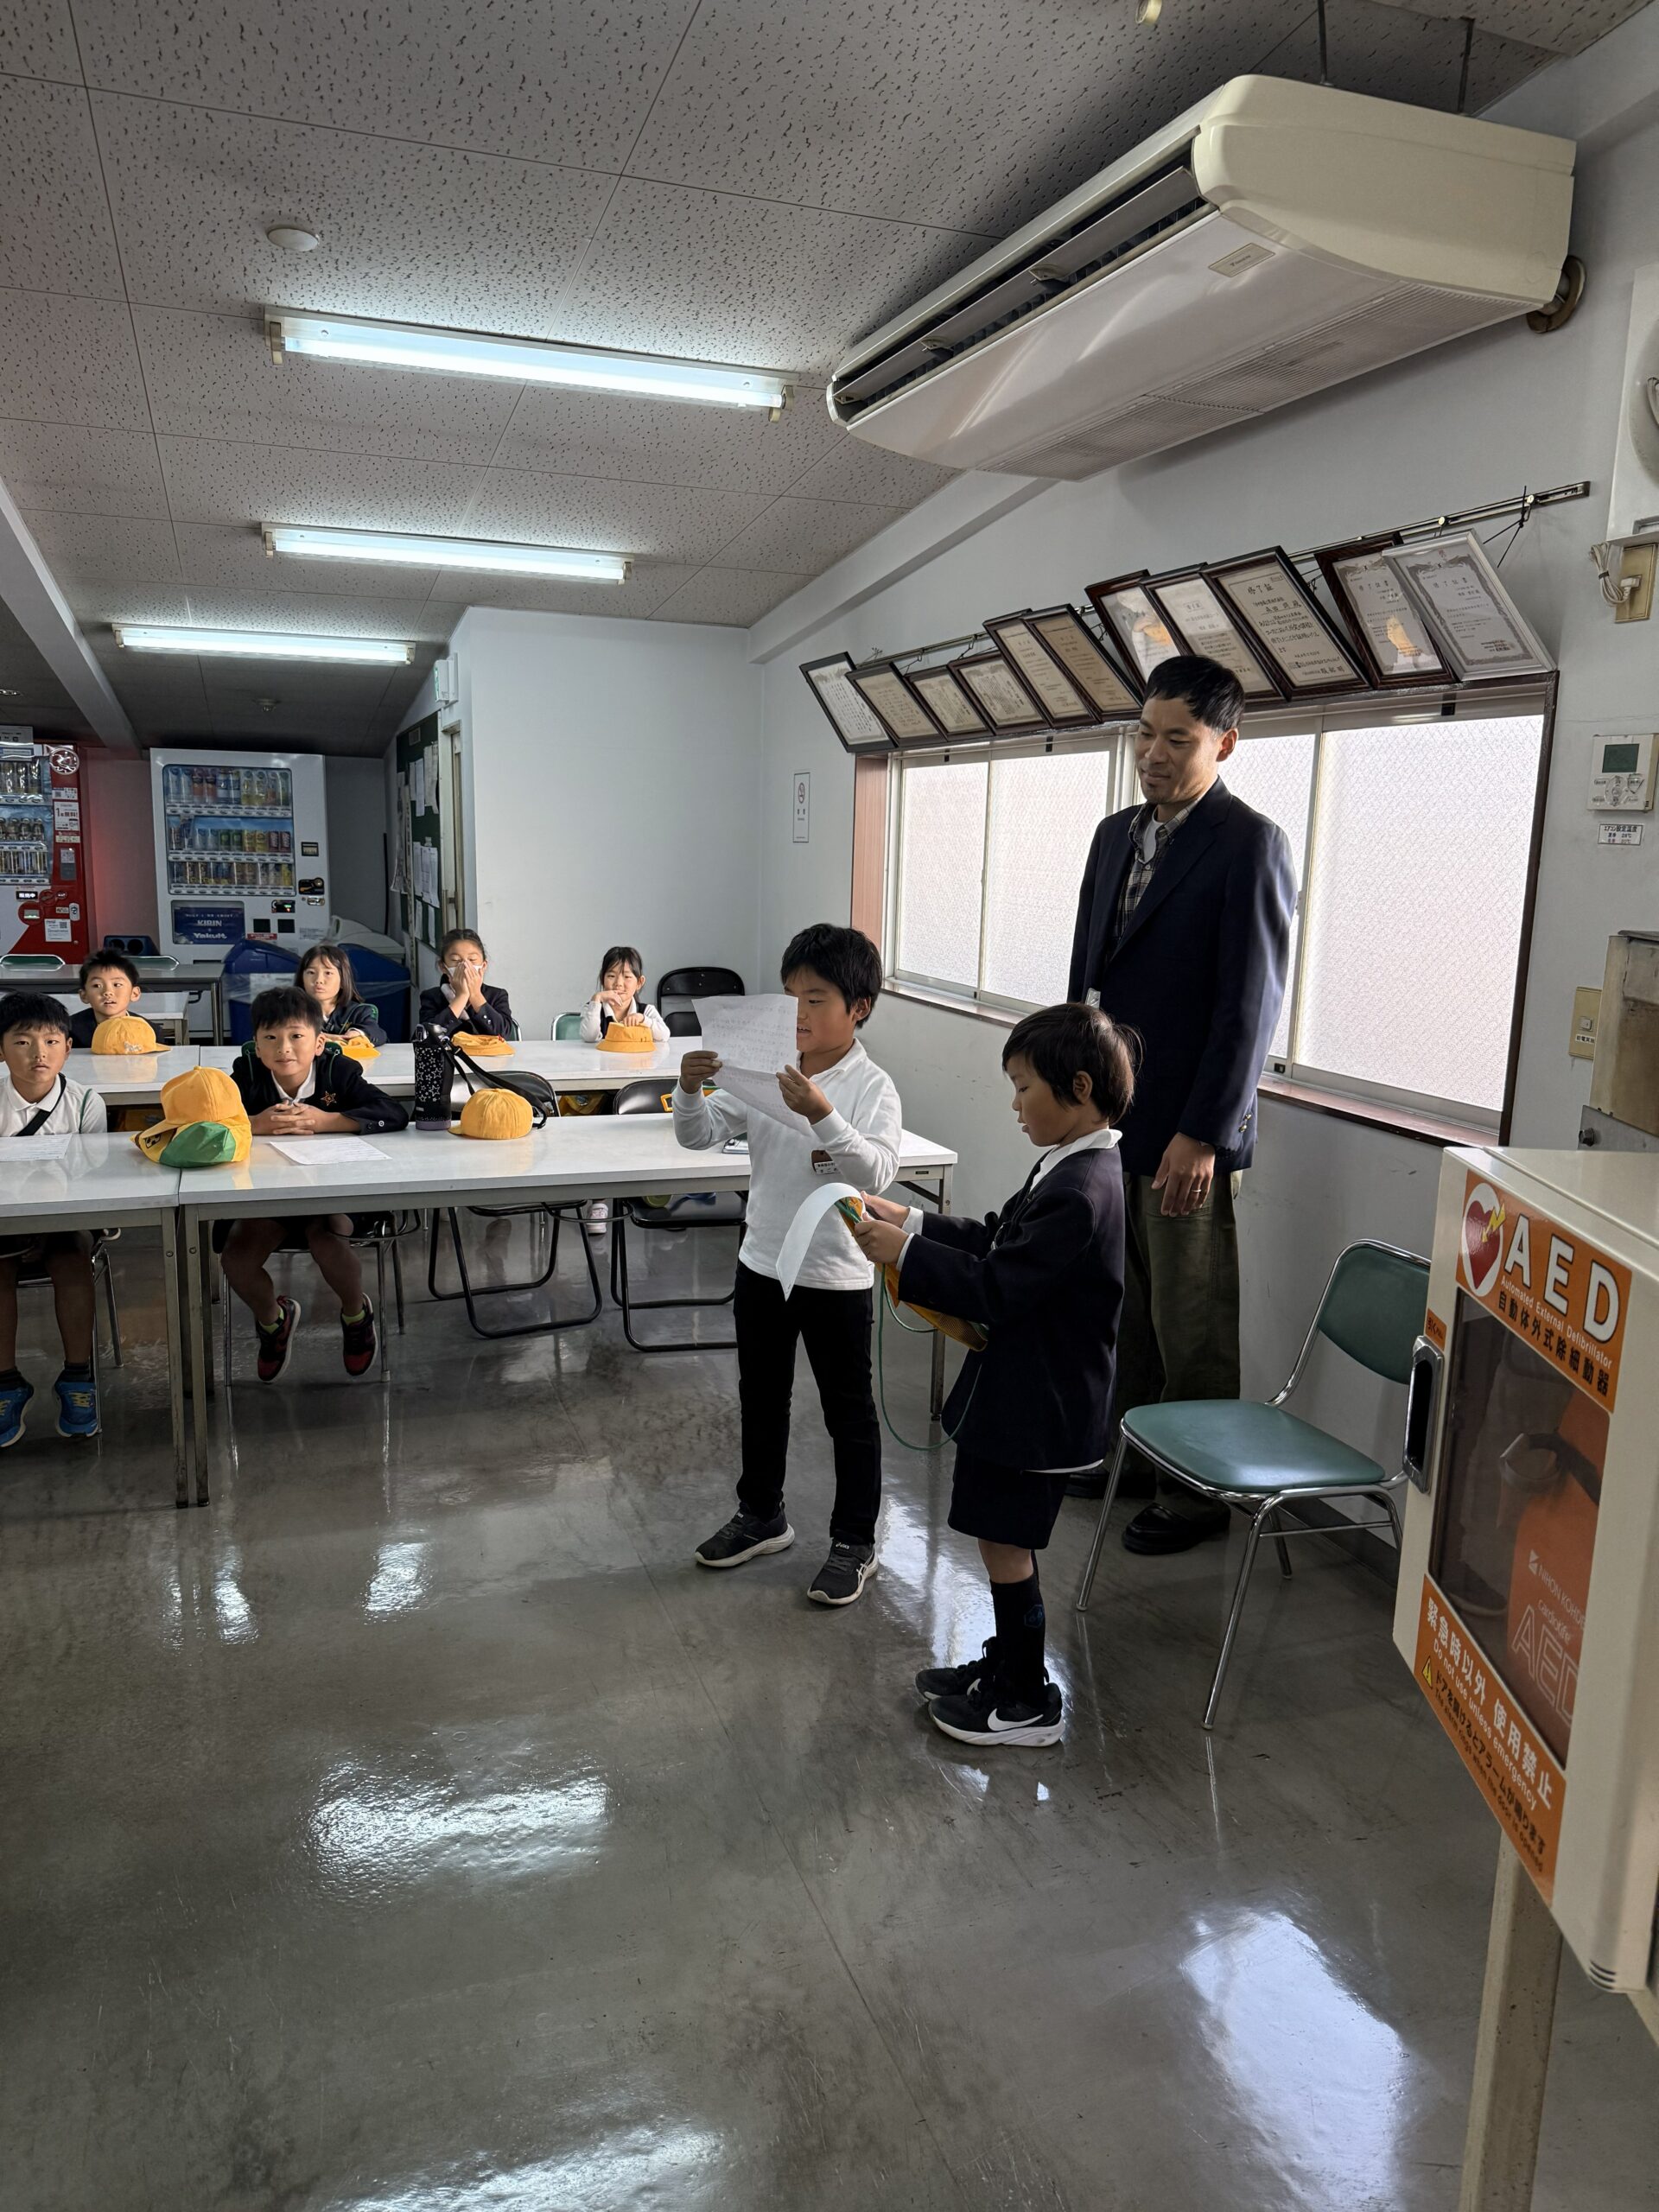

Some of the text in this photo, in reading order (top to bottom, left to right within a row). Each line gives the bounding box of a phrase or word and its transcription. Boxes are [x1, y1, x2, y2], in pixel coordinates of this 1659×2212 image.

[1501, 1274, 1612, 1370] Automated External Defibrillator
[1503, 1213, 1620, 1344] AED
[1497, 1291, 1609, 1397] 自動体外式除細動器
[1538, 1565, 1586, 1630] NIHON KOHDE
[1427, 1596, 1553, 1811] 緊急時以外 使用禁止
[1433, 1643, 1536, 1812] Do not use unless emergency
